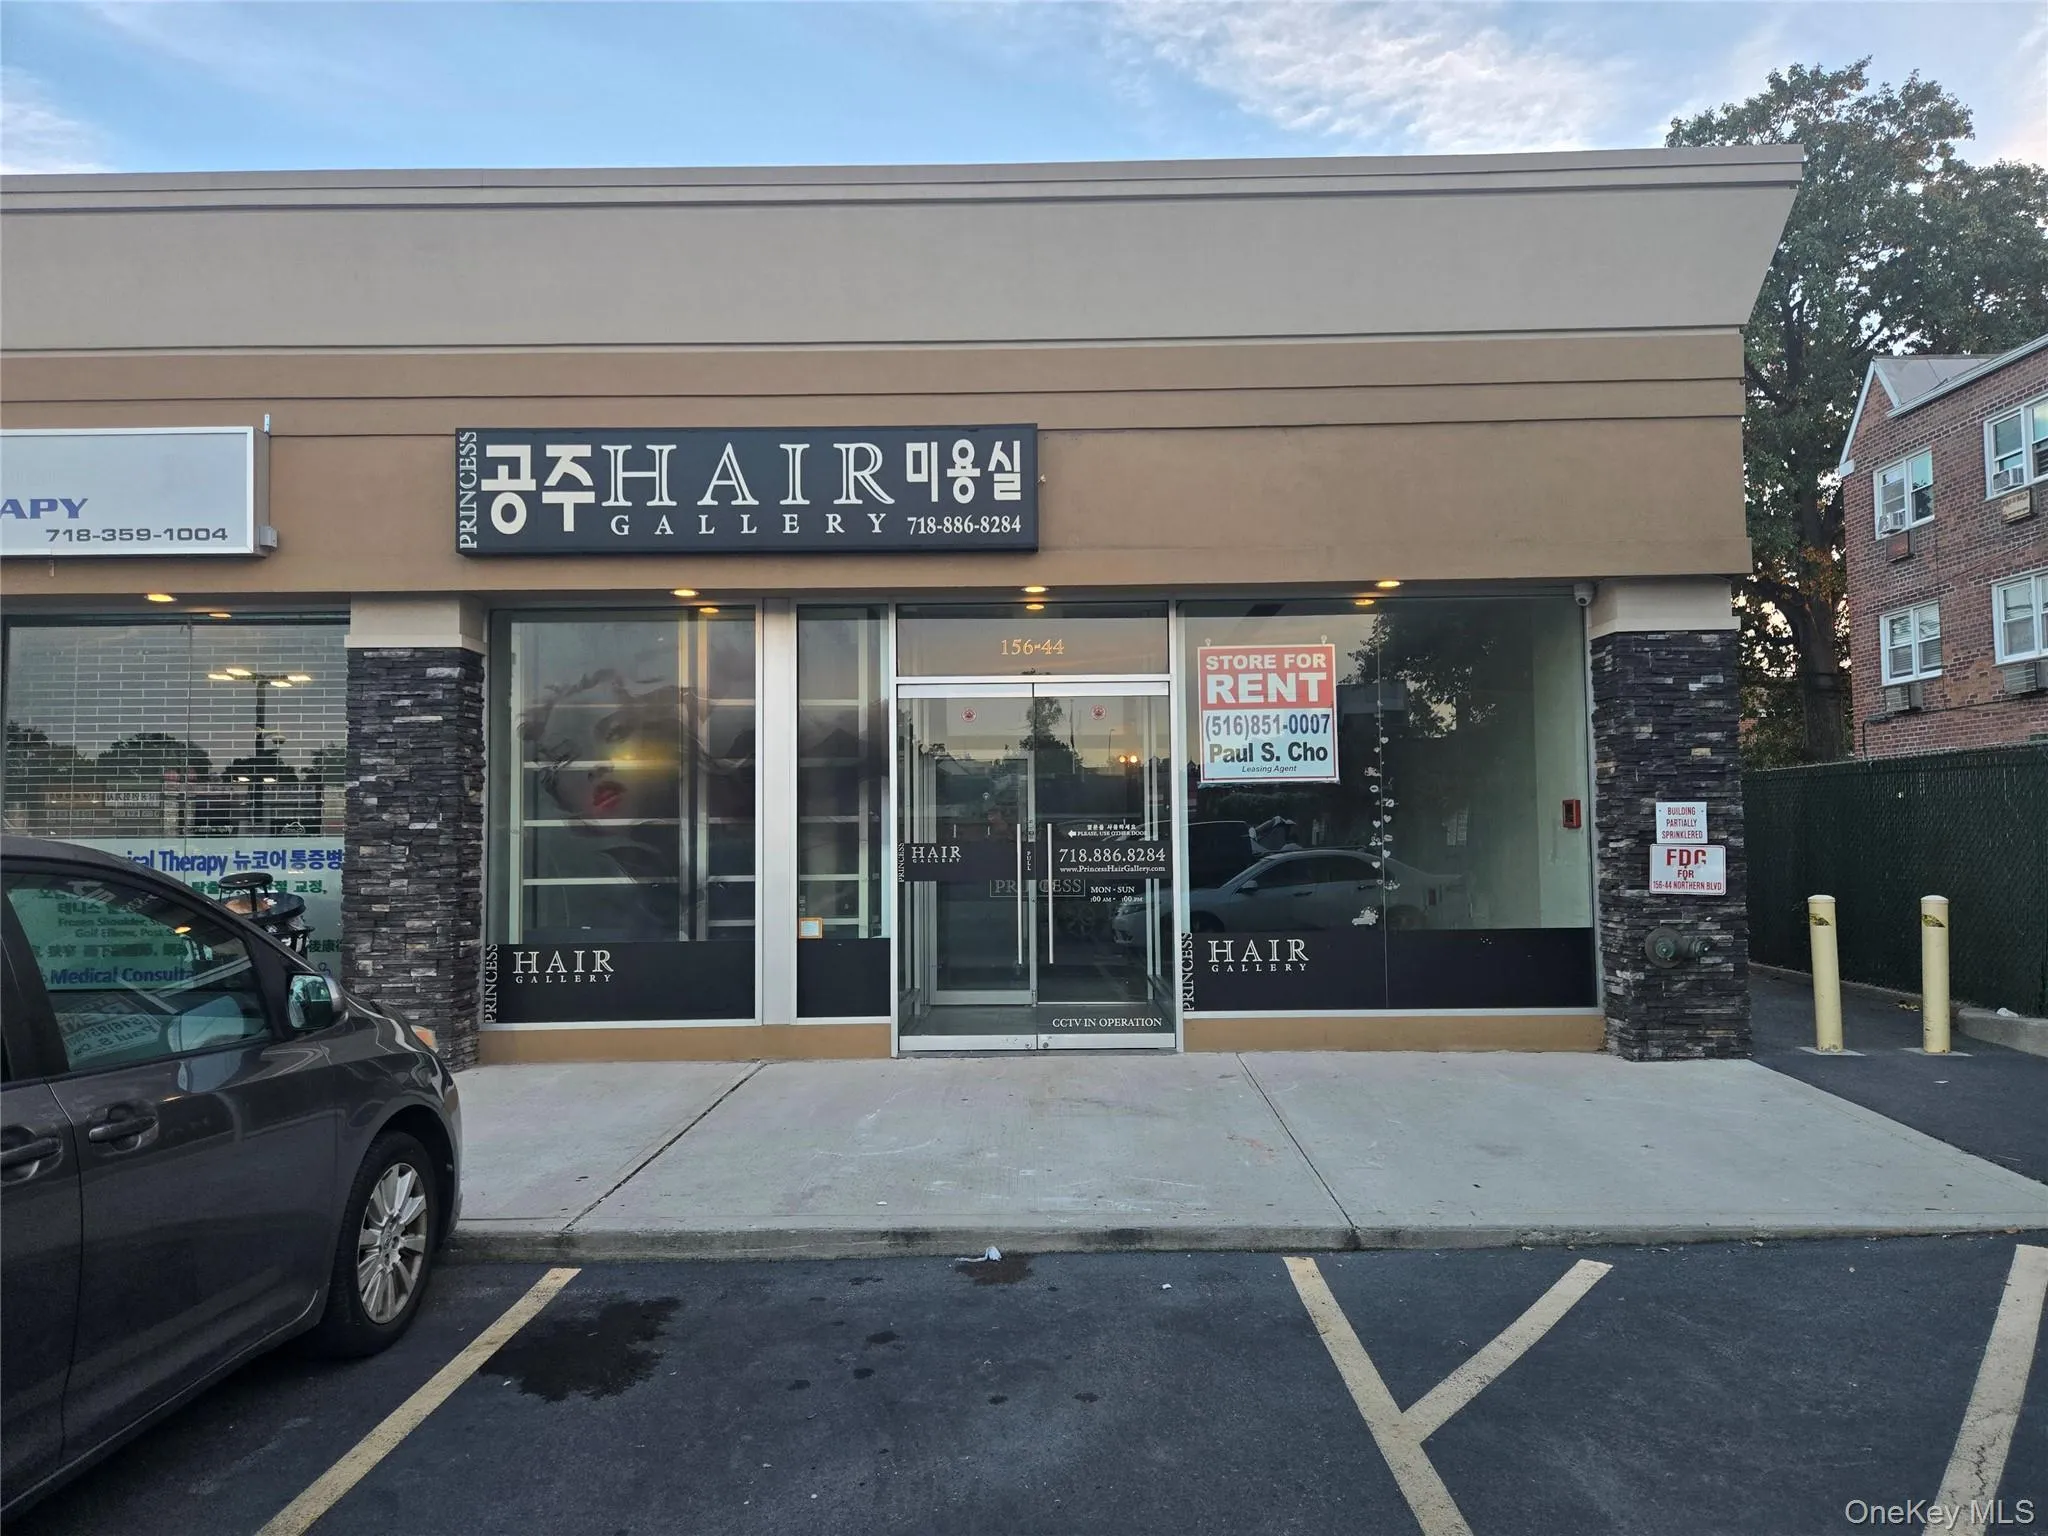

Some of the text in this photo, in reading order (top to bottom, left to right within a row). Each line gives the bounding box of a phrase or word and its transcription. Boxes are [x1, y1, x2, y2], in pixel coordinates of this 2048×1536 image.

[600, 442, 896, 507] HAIR
[905, 439, 1021, 504] 미용실
[458, 430, 477, 550] PRINCESS
[481, 444, 596, 536] 공주
[0, 498, 88, 519] APY
[610, 513, 887, 536] GALLERY
[907, 514, 1021, 536] 718-886-8284
[46, 527, 228, 542] 718-359-1004
[1000, 638, 1065, 655] 156-44
[1205, 653, 1327, 671] STORE FOR
[1206, 672, 1327, 704] RENT
[1205, 713, 1331, 741] (516)851-0007
[1209, 741, 1328, 763] Paul S. Cho
[1241, 765, 1297, 774] Leasing Agent
[1667, 806, 1696, 816] BUILDING
[1666, 818, 1698, 828] PARTIALLY
[1662, 830, 1704, 840] SPRINKLERED
[233, 850, 286, 870] 뉴코어
[911, 846, 962, 859] HAIR
[1059, 848, 1166, 863] 718.886.8284
[159, 850, 228, 876] Therapy
[1060, 864, 1166, 874] www.PrincessHairGallery.com
[1678, 870, 1694, 879] FOR
[1090, 886, 1112, 894] MON
[1653, 880, 1722, 890] 156-44 NORTHERN BLVD
[1208, 939, 1310, 963] HAIR
[512, 950, 614, 974] HAIR
[1211, 963, 1307, 972] GALLERY
[51, 966, 118, 984] Medical
[515, 974, 612, 984] GALLERY
[1182, 932, 1195, 1011] PRINCESS
[484, 943, 498, 1024] PRINCESS
[1052, 1017, 1163, 1028] CCTV IN OPERATION
